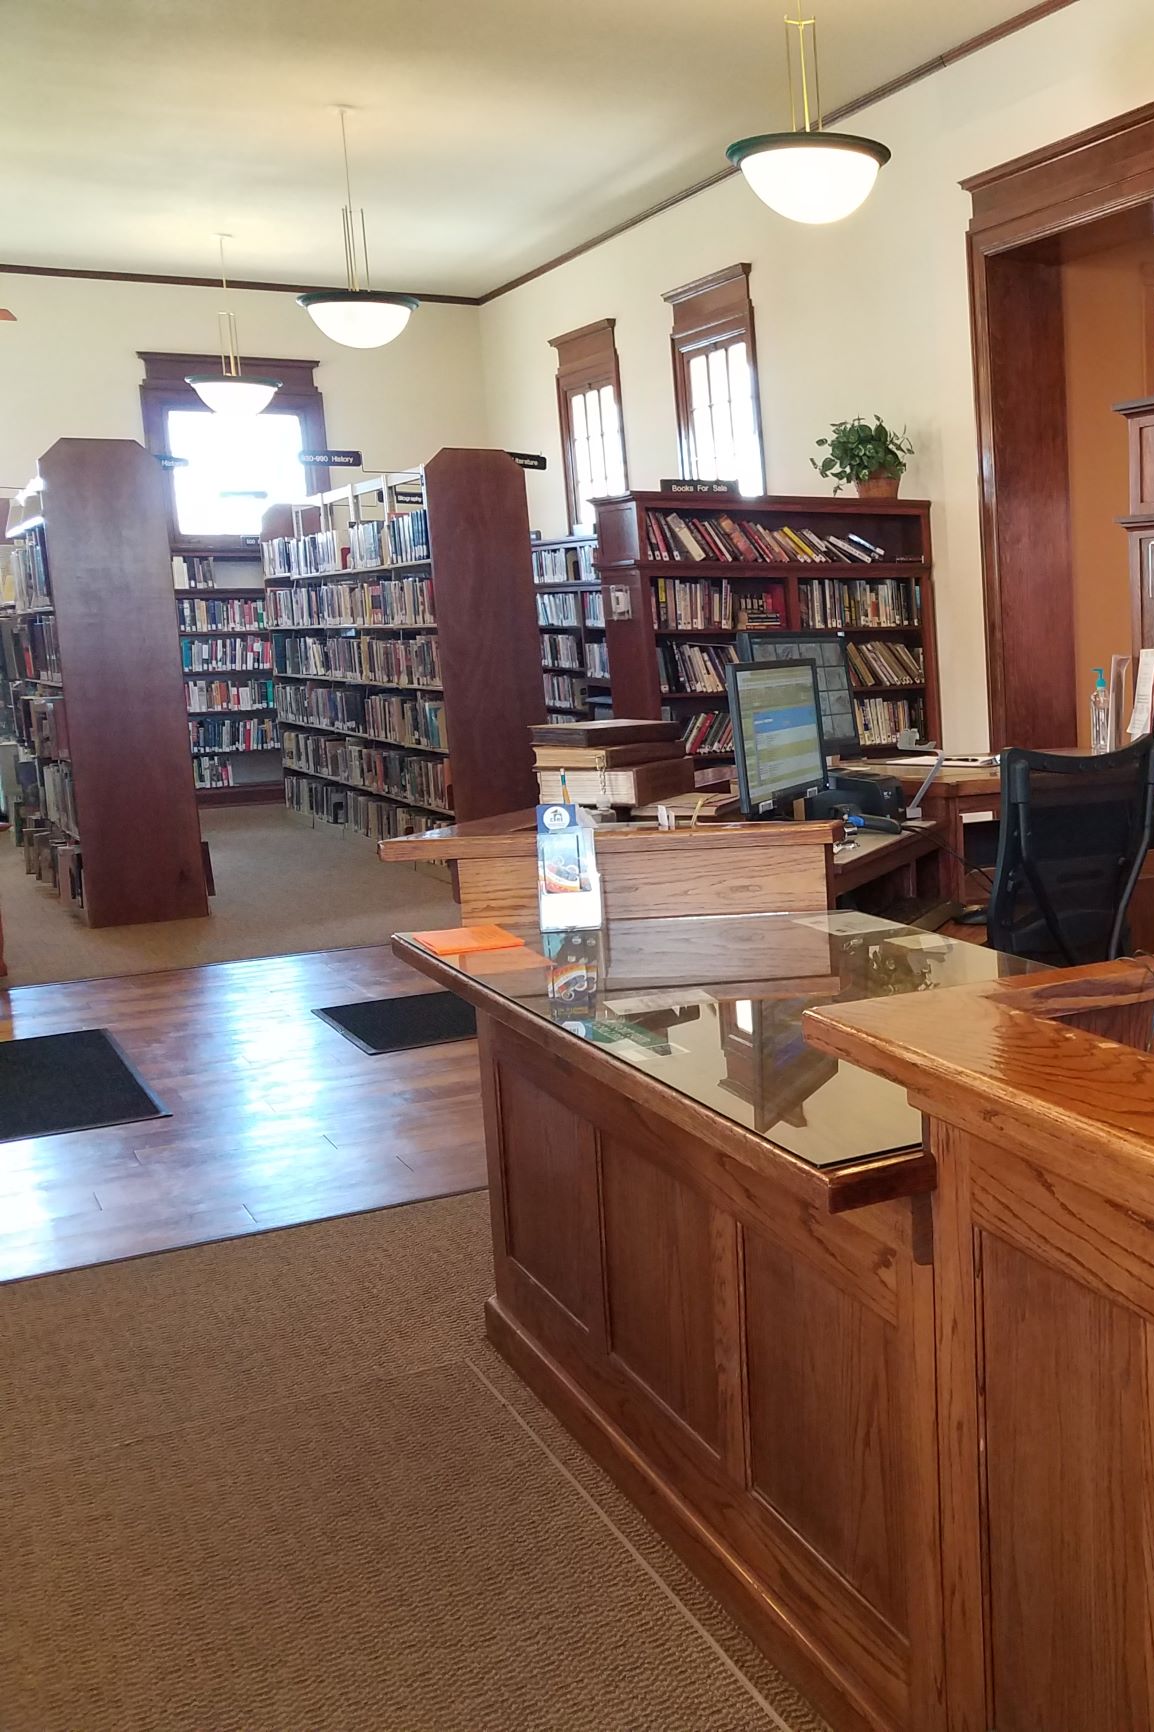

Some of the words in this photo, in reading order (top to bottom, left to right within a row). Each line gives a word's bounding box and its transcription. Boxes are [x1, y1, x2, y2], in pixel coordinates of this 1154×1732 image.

[331, 455, 354, 464] History
[671, 483, 694, 493] Books
[697, 484, 709, 493] For
[712, 484, 728, 493] Sale
[397, 494, 422, 503] Biography
